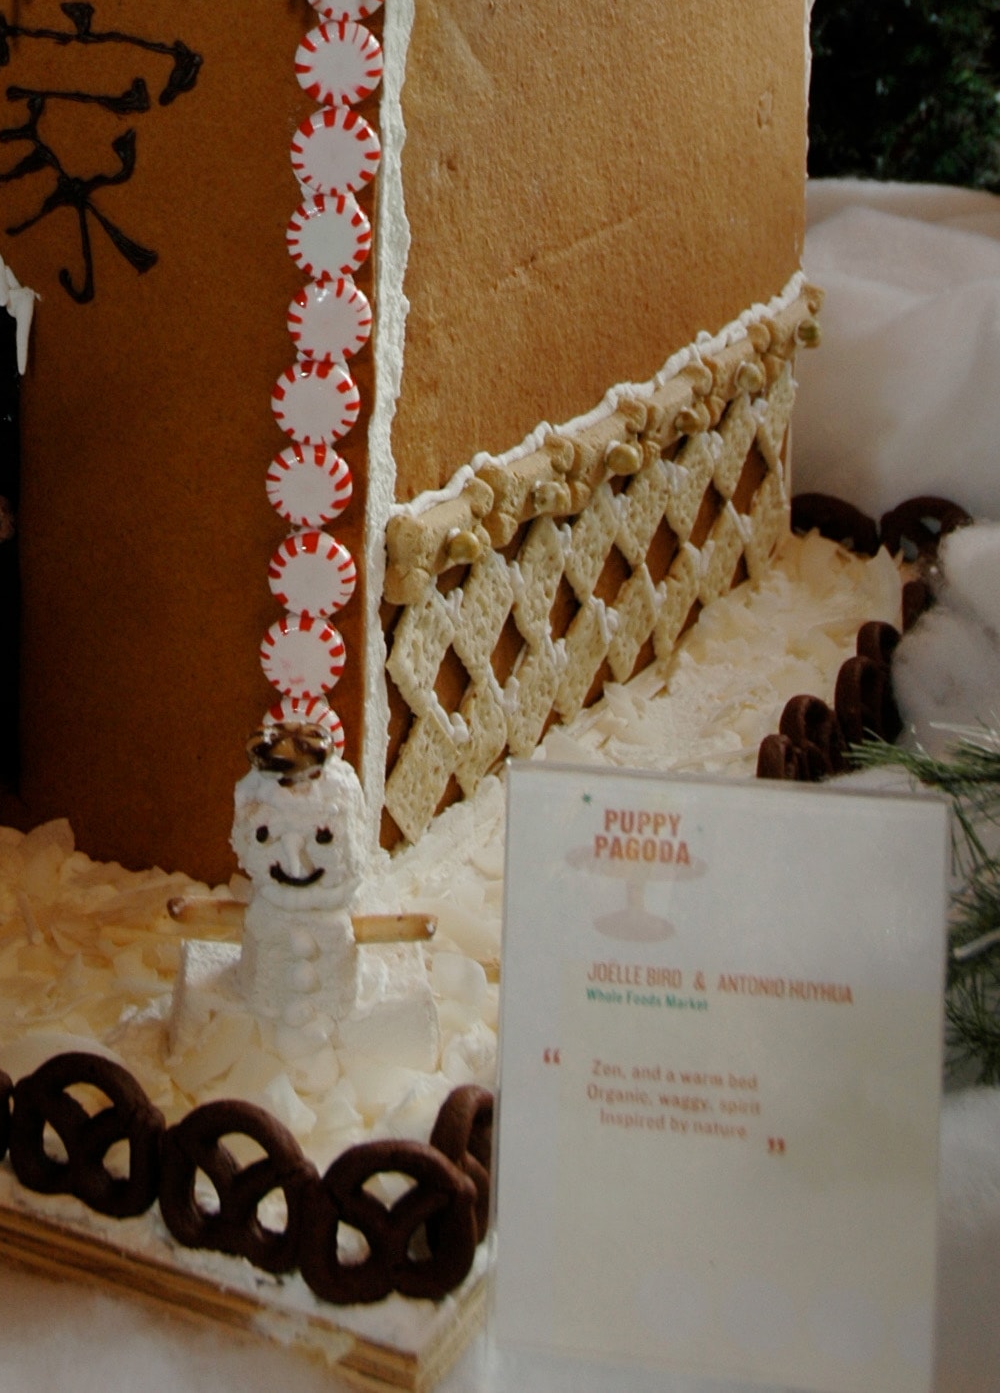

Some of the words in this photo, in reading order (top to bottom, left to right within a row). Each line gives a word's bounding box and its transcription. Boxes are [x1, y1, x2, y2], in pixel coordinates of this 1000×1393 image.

[604, 809, 681, 837] PUPPY
[593, 835, 692, 866] PAGODA
[646, 966, 682, 989] BIRD
[693, 970, 706, 991] &
[718, 973, 785, 998] ANTONIO
[586, 988, 623, 1004] Whole
[626, 990, 662, 1006] Foods
[665, 994, 708, 1010] Market
[592, 1058, 626, 1079] Zen,
[632, 1064, 661, 1081] and
[666, 1069, 675, 1082] a
[680, 1073, 723, 1087] warm
[728, 1073, 758, 1091] bed
[586, 1083, 653, 1106] Organic,
[600, 1108, 665, 1130] Inspired
[670, 1116, 688, 1134] by
